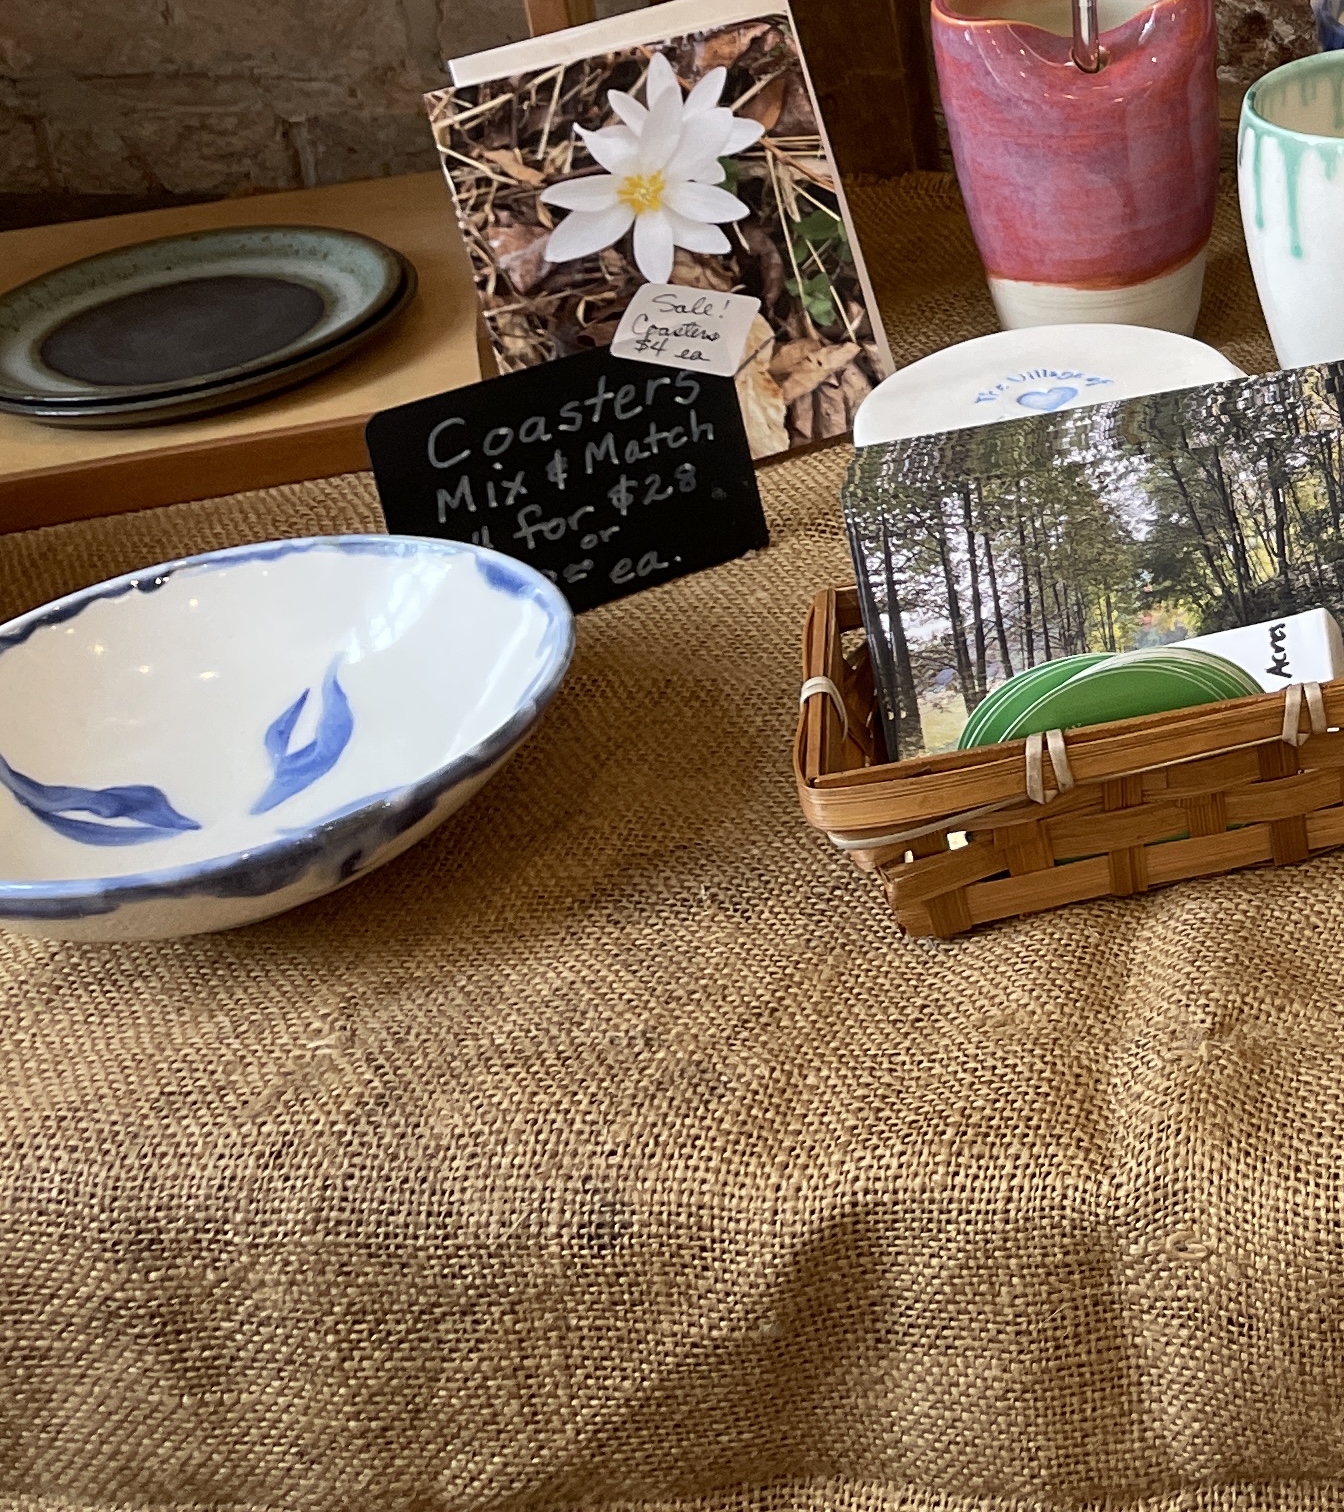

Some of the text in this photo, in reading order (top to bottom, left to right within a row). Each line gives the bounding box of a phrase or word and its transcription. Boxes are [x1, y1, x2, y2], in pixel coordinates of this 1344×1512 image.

[652, 292, 730, 319] Sale!
[634, 338, 668, 357] $4
[426, 370, 702, 468] Coasters
[436, 462, 528, 524] Mix
[584, 408, 714, 475] Match
[512, 504, 595, 550] for
[580, 526, 620, 550] or
